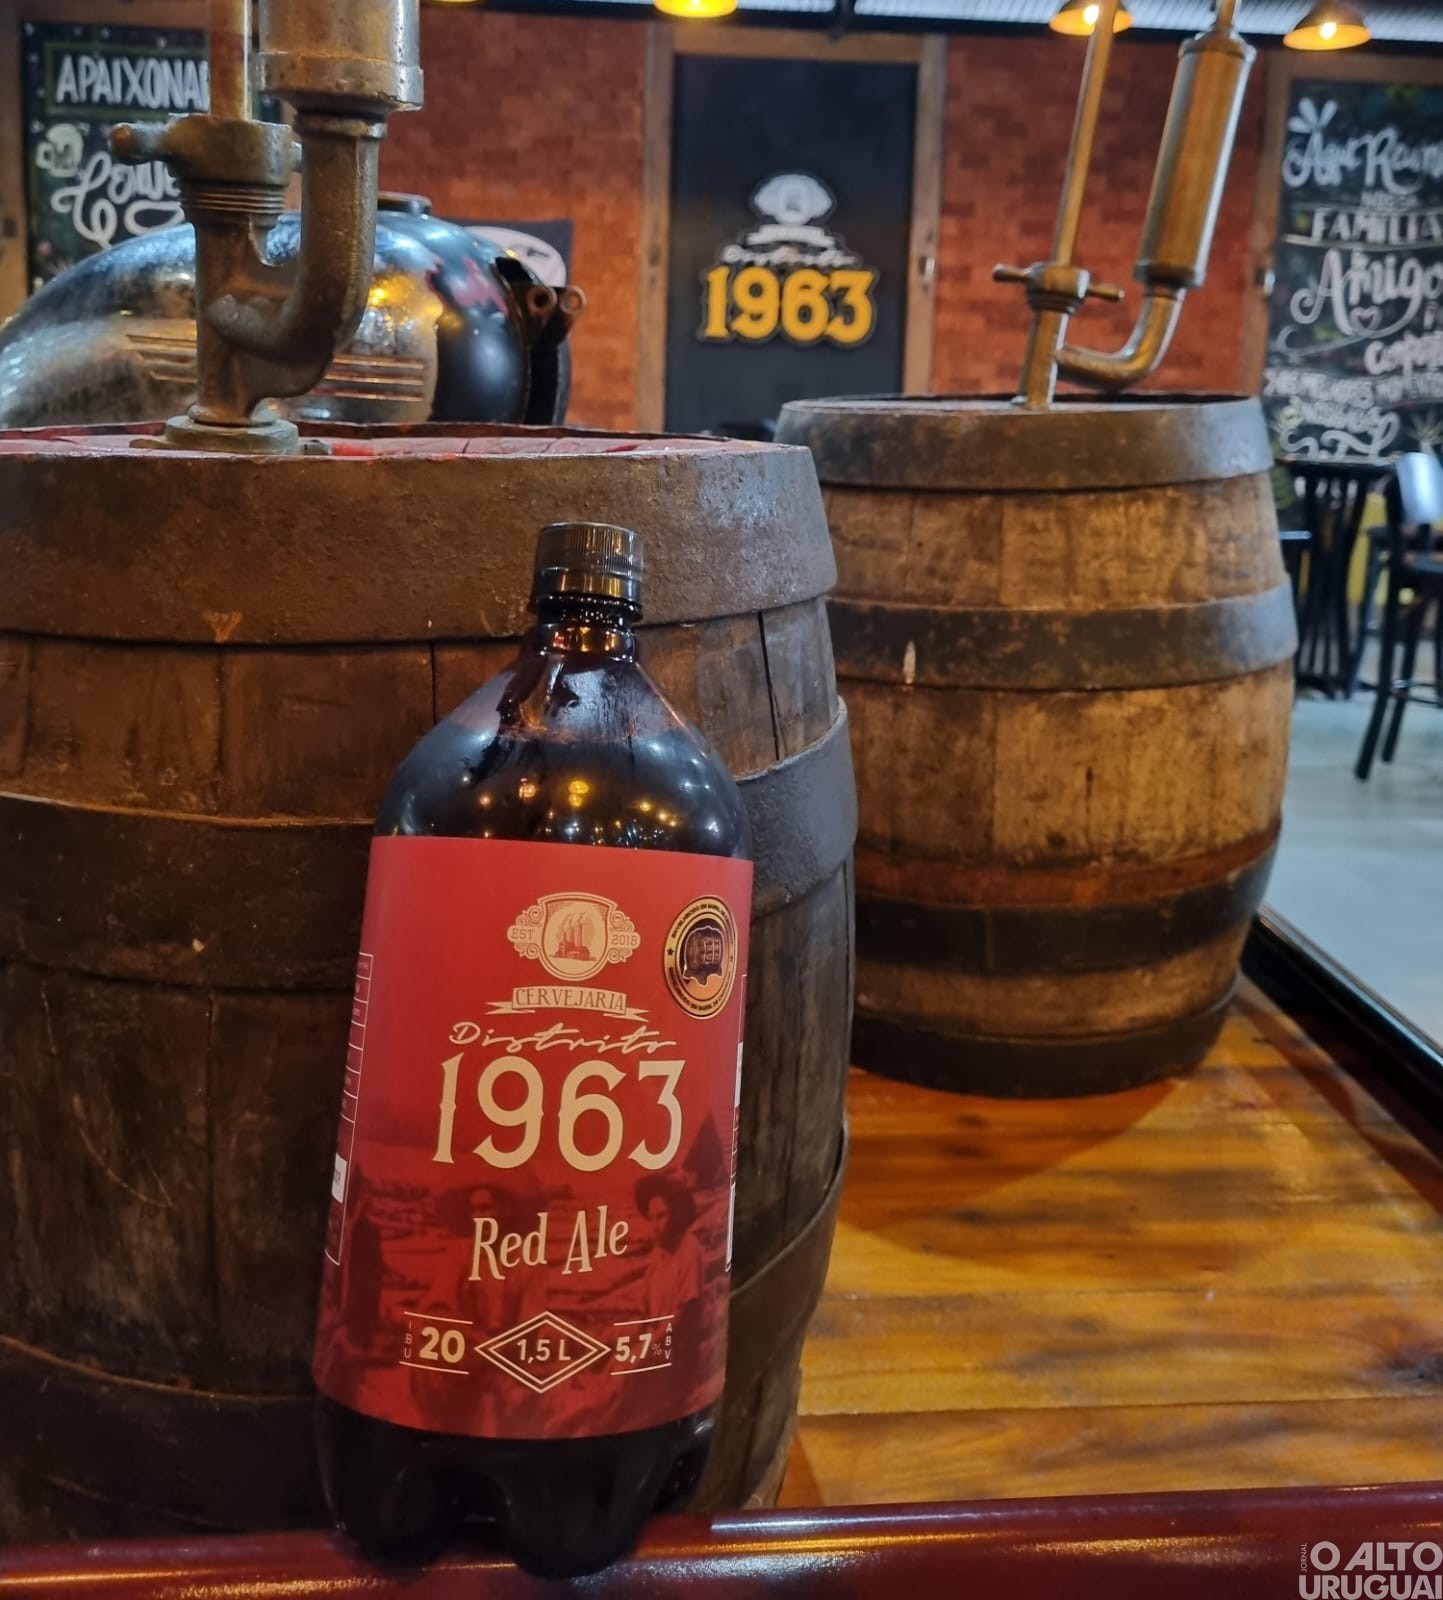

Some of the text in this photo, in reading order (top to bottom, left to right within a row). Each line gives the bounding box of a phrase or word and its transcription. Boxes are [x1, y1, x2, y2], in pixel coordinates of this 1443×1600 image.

[704, 265, 876, 344] 1963
[511, 928, 638, 946] EST 2018
[515, 988, 625, 1012] CERVEJARIA
[449, 1021, 677, 1054] Distrito
[432, 1052, 687, 1172] 1963
[468, 1205, 630, 1281] Red Ale
[419, 1326, 465, 1363] 20
[516, 1338, 572, 1364] 1,5 L
